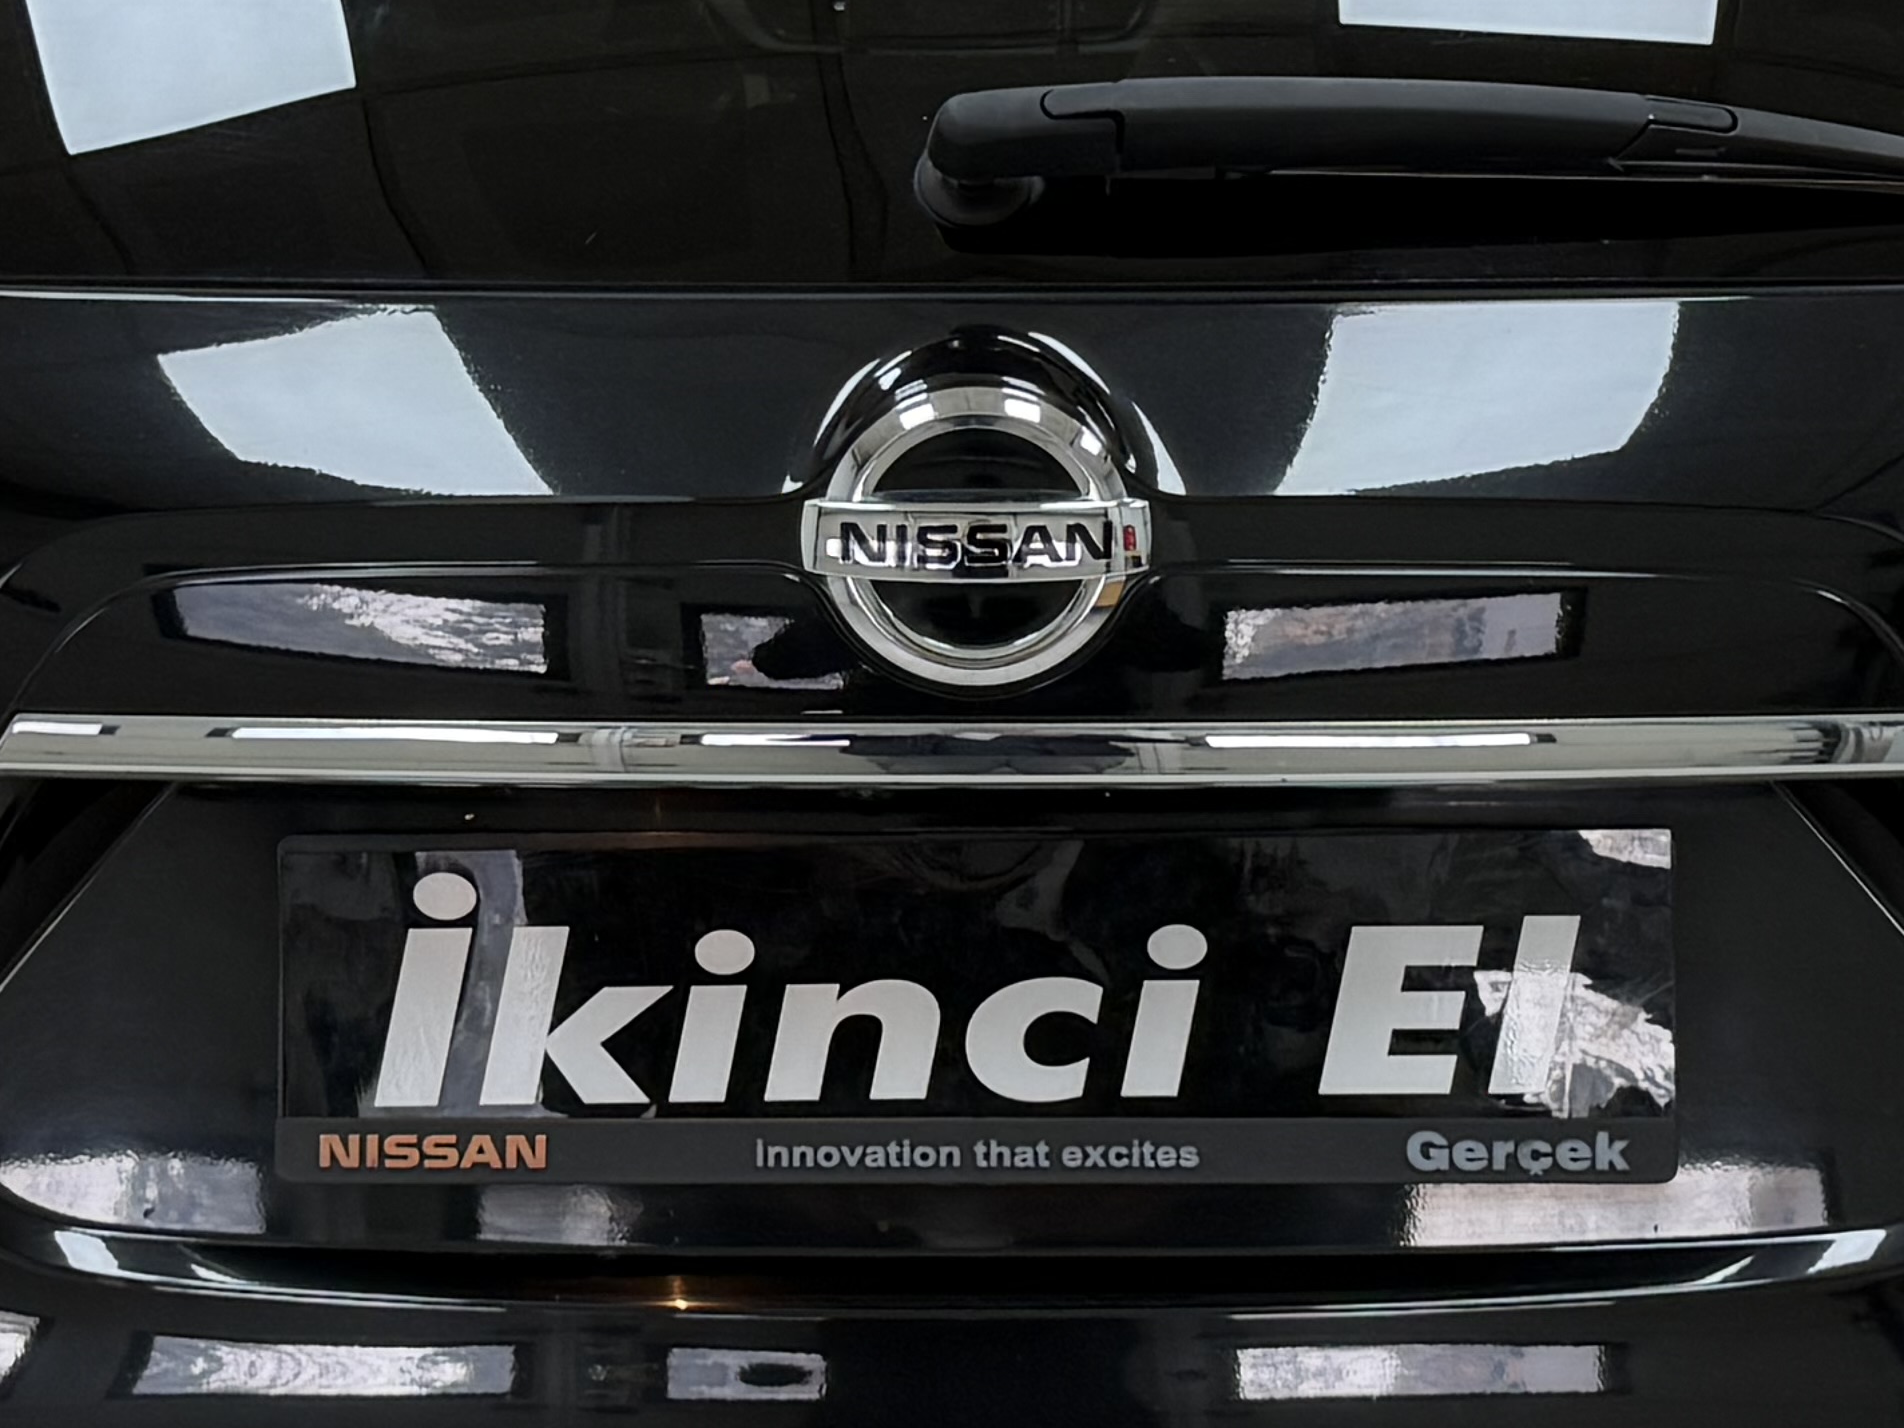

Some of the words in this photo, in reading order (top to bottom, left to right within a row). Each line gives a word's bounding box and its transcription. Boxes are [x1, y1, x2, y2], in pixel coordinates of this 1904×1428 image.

[838, 520, 1114, 568] NISSAN
[372, 871, 1208, 1108] İkinci
[1317, 914, 1582, 1097] El
[319, 1133, 547, 1170] NISSAN
[755, 1138, 962, 1169] Innovation
[973, 1138, 1051, 1169] that
[1060, 1138, 1201, 1169] excites
[1406, 1129, 1631, 1176] Gerçek
